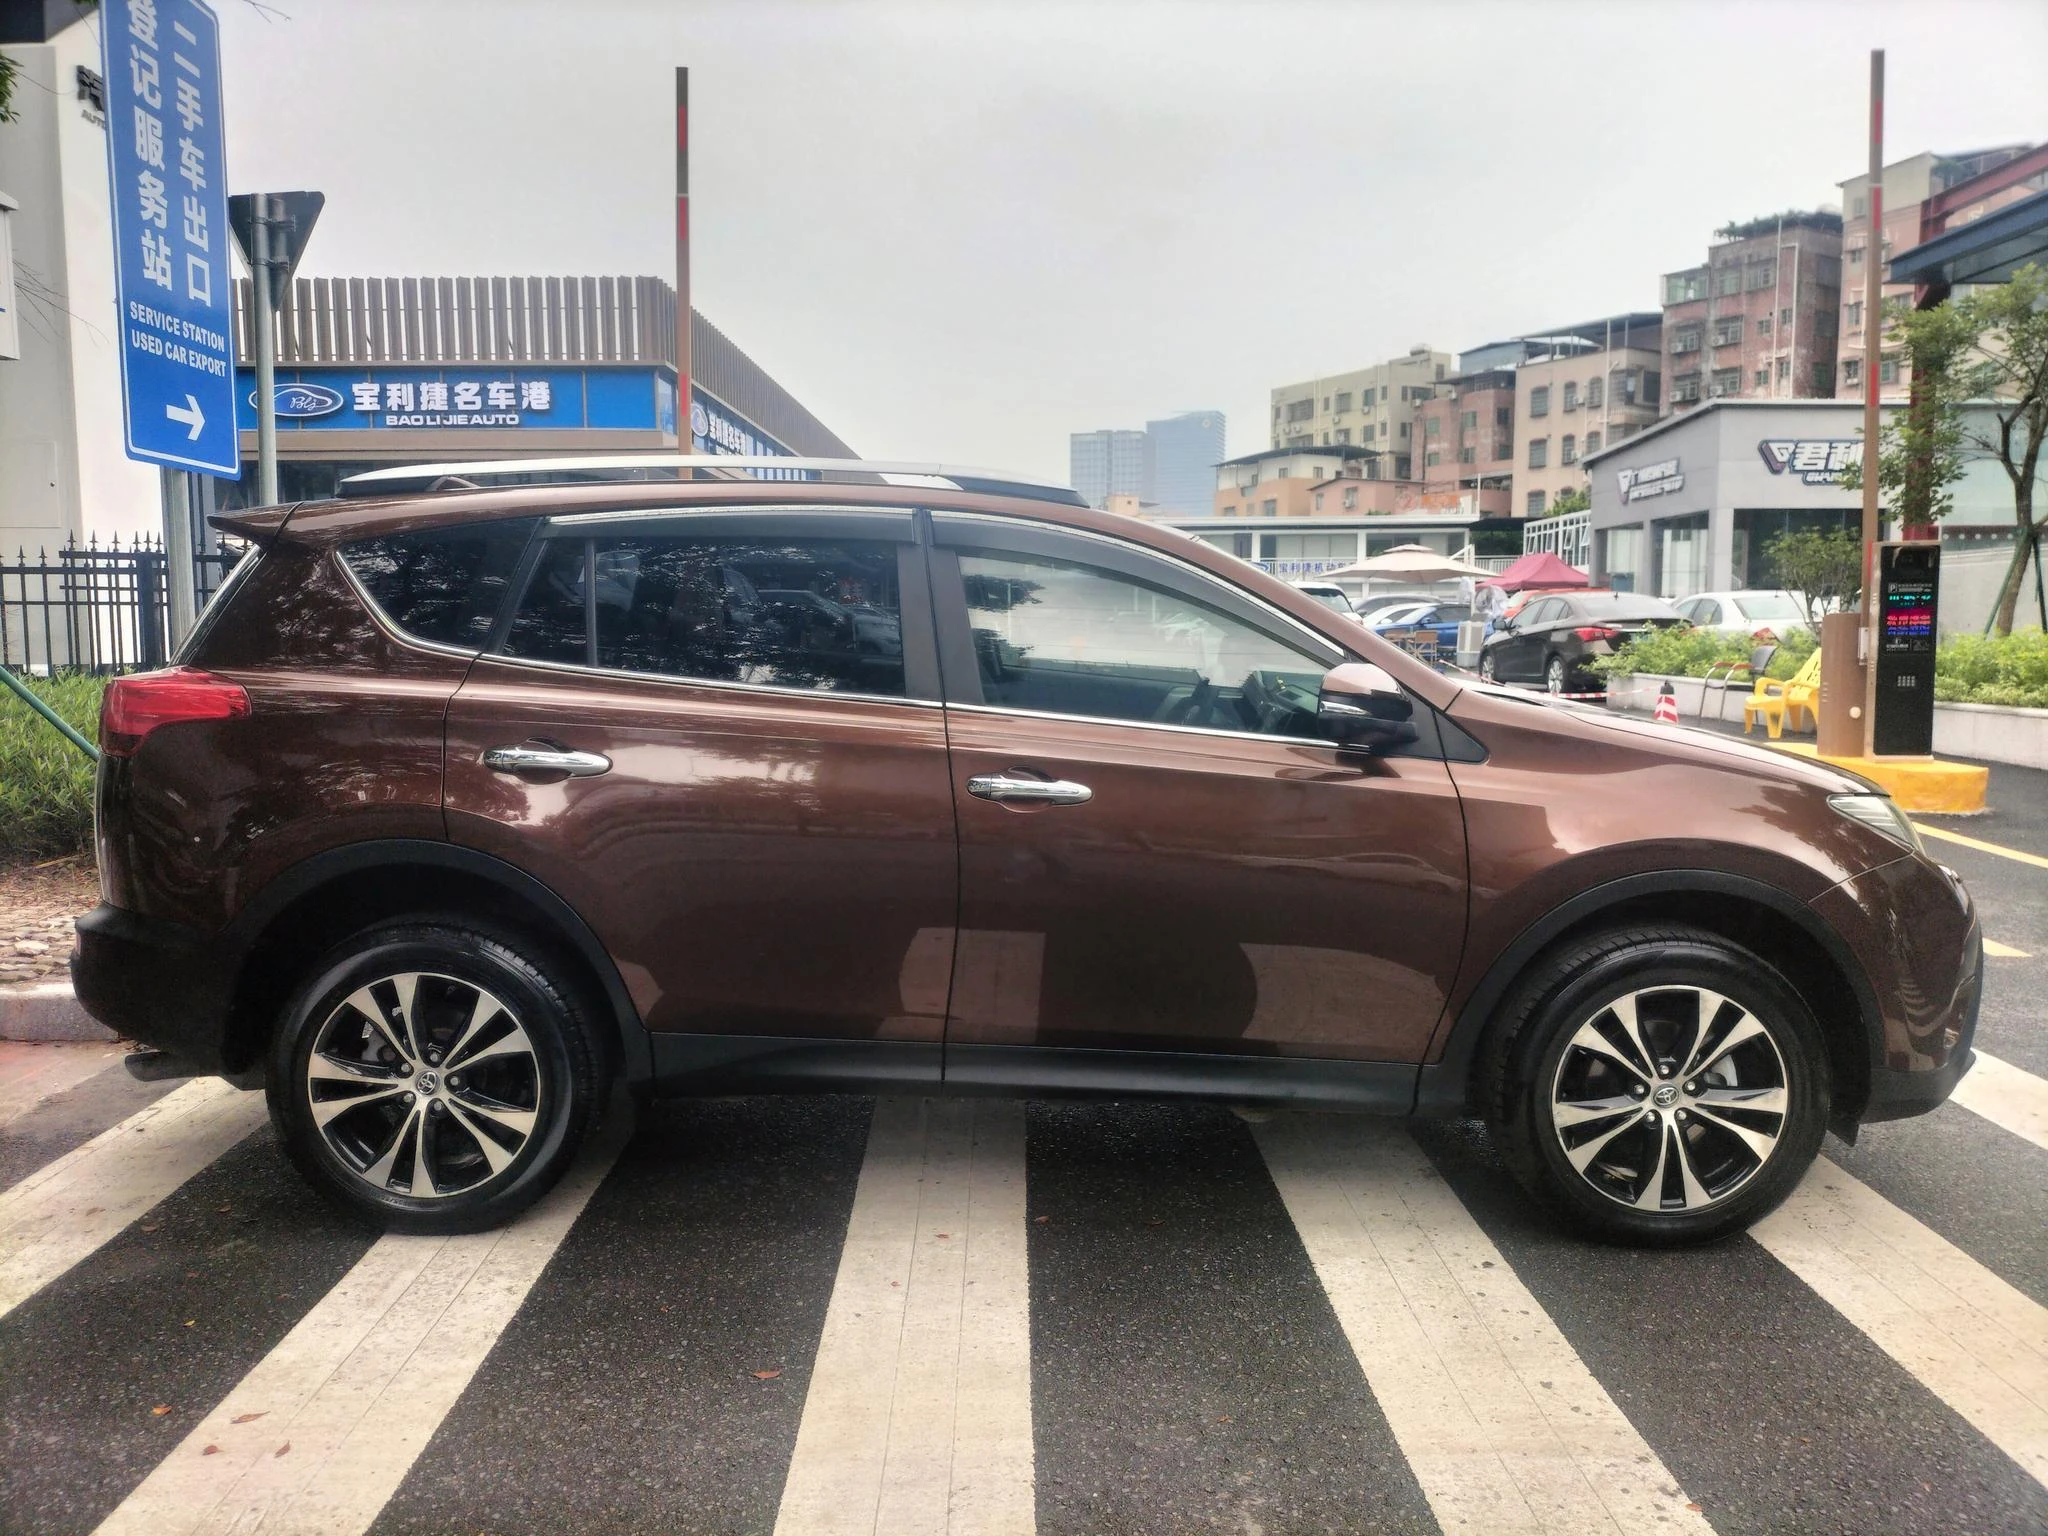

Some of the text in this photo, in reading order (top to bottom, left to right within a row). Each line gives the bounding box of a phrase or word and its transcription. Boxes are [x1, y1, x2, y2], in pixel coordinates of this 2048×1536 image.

[127, 0, 172, 291] 登记服务站
[174, 20, 211, 307] 二手车出口
[129, 300, 225, 353] SERVICE STATION
[131, 328, 227, 377] USED CAR EXPORT
[351, 381, 550, 412] 宝利捷名车港
